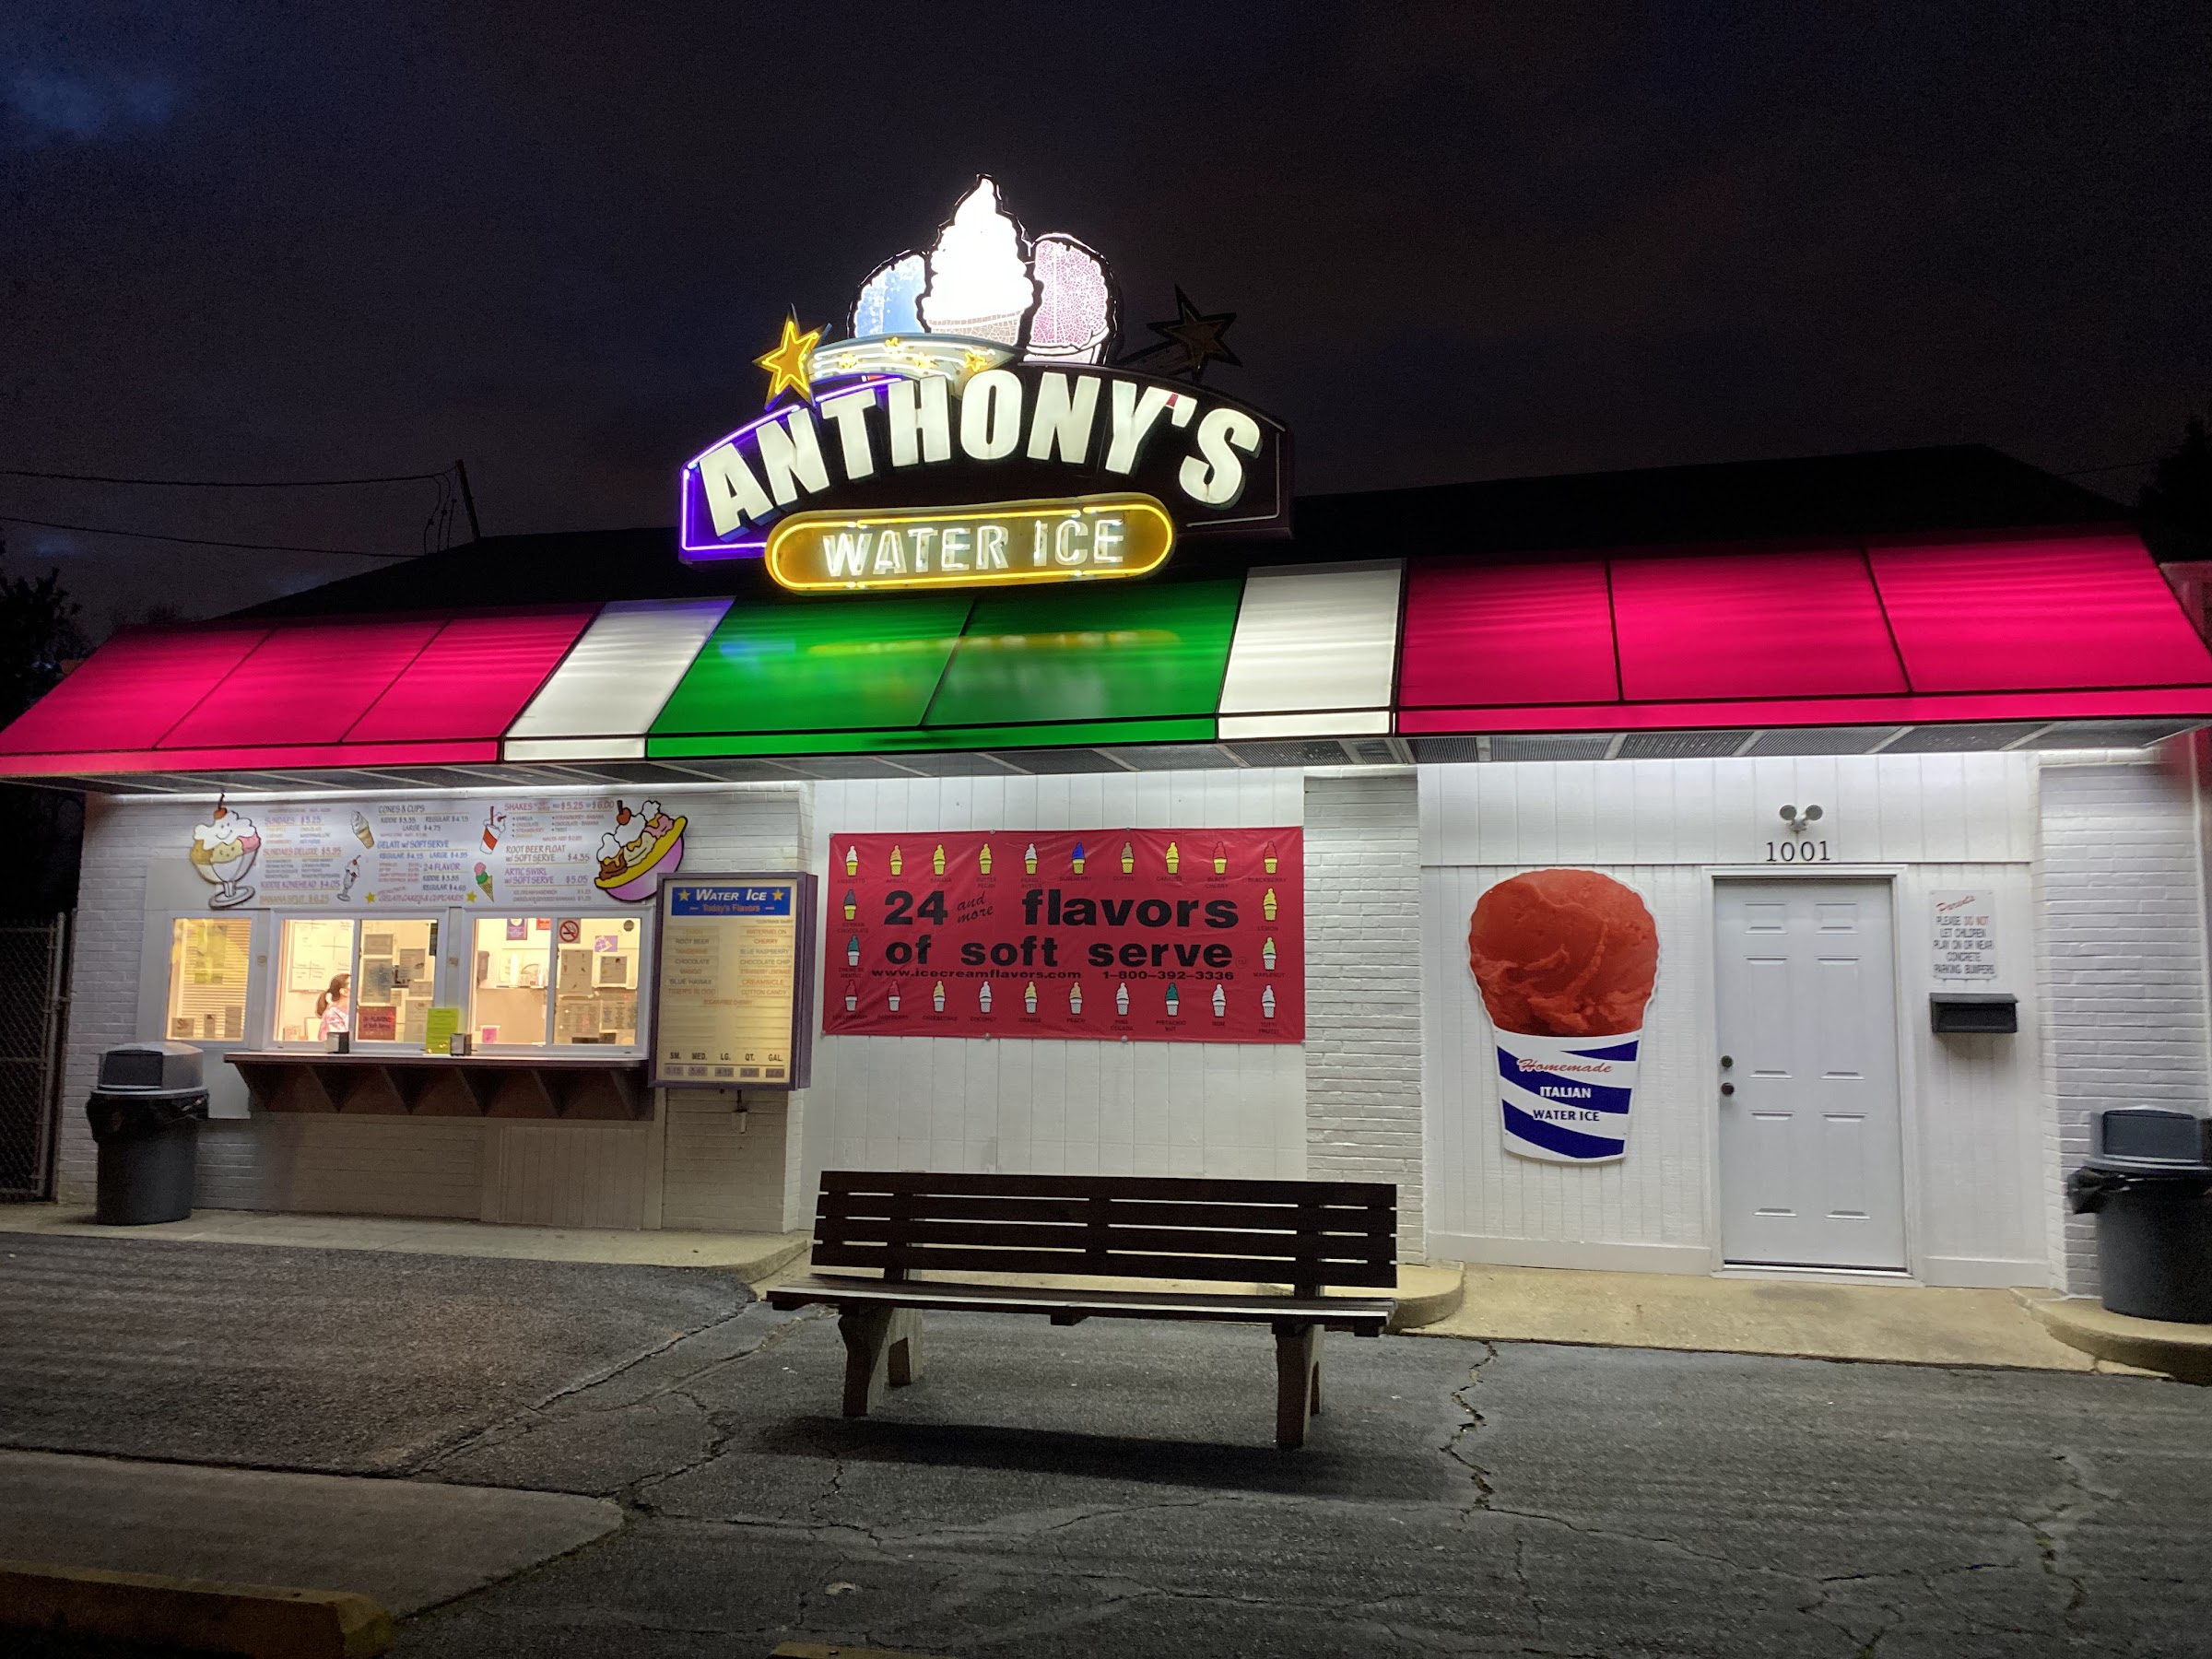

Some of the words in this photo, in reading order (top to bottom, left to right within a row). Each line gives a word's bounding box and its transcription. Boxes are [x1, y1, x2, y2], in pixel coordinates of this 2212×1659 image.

[699, 370, 1260, 536] ANTHONY'S
[822, 524, 1009, 578] WATER
[1033, 517, 1124, 568] ICE
[379, 805, 400, 813] CONES
[407, 804, 425, 813] CUPS
[504, 802, 534, 811] SHAKES
[560, 801, 583, 811] $5.25
[592, 800, 615, 809] $6.00
[377, 840, 400, 849] GELATI
[409, 841, 426, 849] SOFT
[427, 840, 449, 848] SERVE
[506, 845, 524, 853] ROOT
[525, 844, 544, 853] BEER
[545, 844, 566, 853] FLOAT
[513, 853, 532, 862] SOFT
[533, 853, 556, 862] SERVE
[1766, 841, 1830, 862] 1001
[423, 863, 433, 871] 24
[434, 862, 461, 871] FLAVOR
[504, 867, 525, 876] ARTIC
[525, 867, 547, 876] SWIRL
[512, 876, 531, 884] SOFT
[531, 876, 555, 884] SERVE
[566, 875, 589, 884] $5.05
[696, 888, 739, 901] WATER
[746, 888, 768, 901] ICE
[957, 890, 987, 912] and
[884, 889, 948, 925] 24
[1022, 888, 1239, 928] flavors
[957, 905, 994, 924] more
[885, 934, 932, 965] of
[960, 935, 1058, 967] soft
[1088, 942, 1233, 968] serve
[871, 968, 1082, 979] www.icecreamflavors.com
[1102, 971, 1234, 981] 1-800-392-3336
[669, 1052, 682, 1060] SM.
[691, 1052, 708, 1061] MED.
[720, 1053, 732, 1061] LG.
[768, 1053, 783, 1062] GAL.
[1518, 1058, 1612, 1073] Homemade
[1540, 1086, 1592, 1099] ITALIAN
[1533, 1109, 1575, 1121] WATER
[1580, 1111, 1600, 1122] ICE
